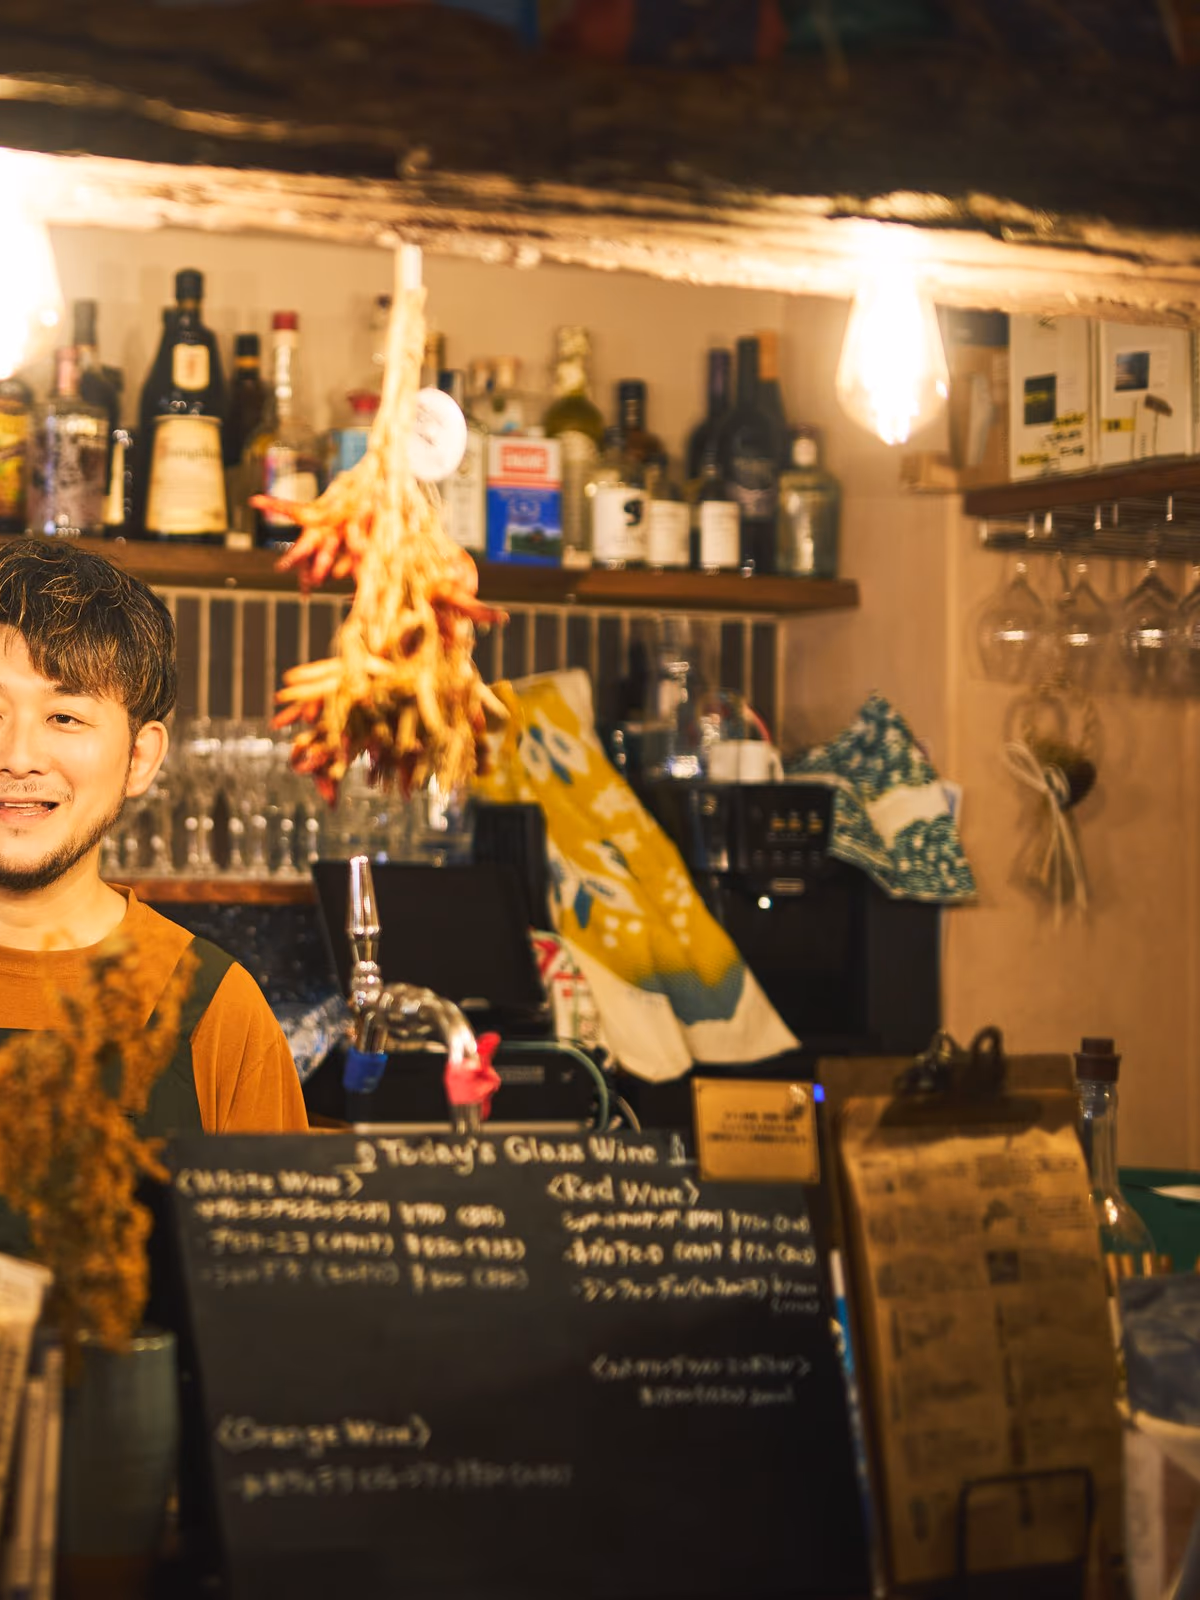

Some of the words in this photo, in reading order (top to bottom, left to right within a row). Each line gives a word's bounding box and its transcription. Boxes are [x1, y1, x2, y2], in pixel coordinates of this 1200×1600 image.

[378, 1136, 496, 1176] Today's
[503, 1136, 585, 1164] Glass
[589, 1136, 658, 1164] Wine
